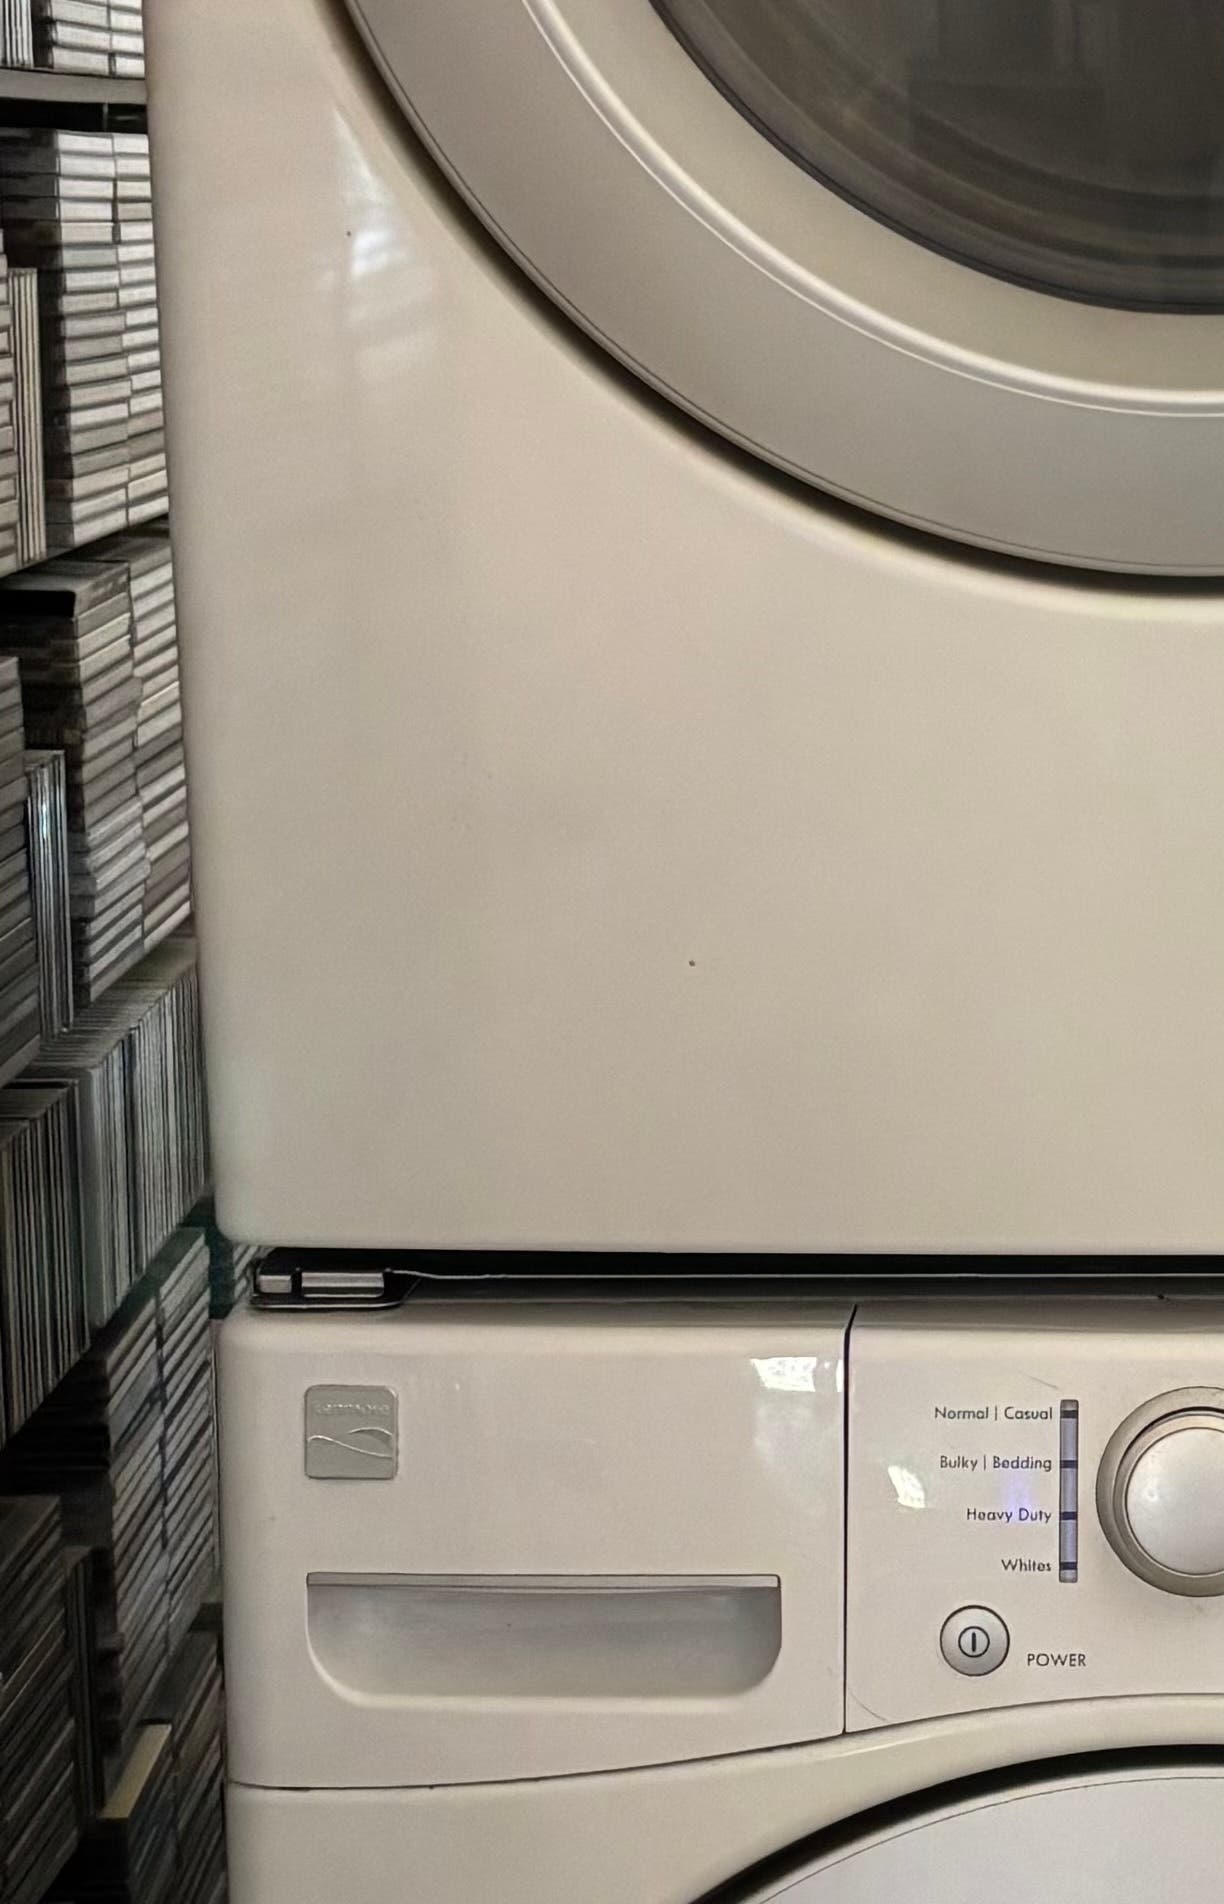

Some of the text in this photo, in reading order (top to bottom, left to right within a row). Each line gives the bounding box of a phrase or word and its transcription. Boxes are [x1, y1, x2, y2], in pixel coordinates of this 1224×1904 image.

[935, 1407, 988, 1419] Normal
[1005, 1407, 1052, 1420] Casual
[941, 1456, 977, 1471] Bulky
[993, 1456, 1051, 1472] Bedding
[967, 1508, 1051, 1523] Heavy Duty
[1001, 1559, 1051, 1571] Whites
[1028, 1654, 1085, 1666] POWER
